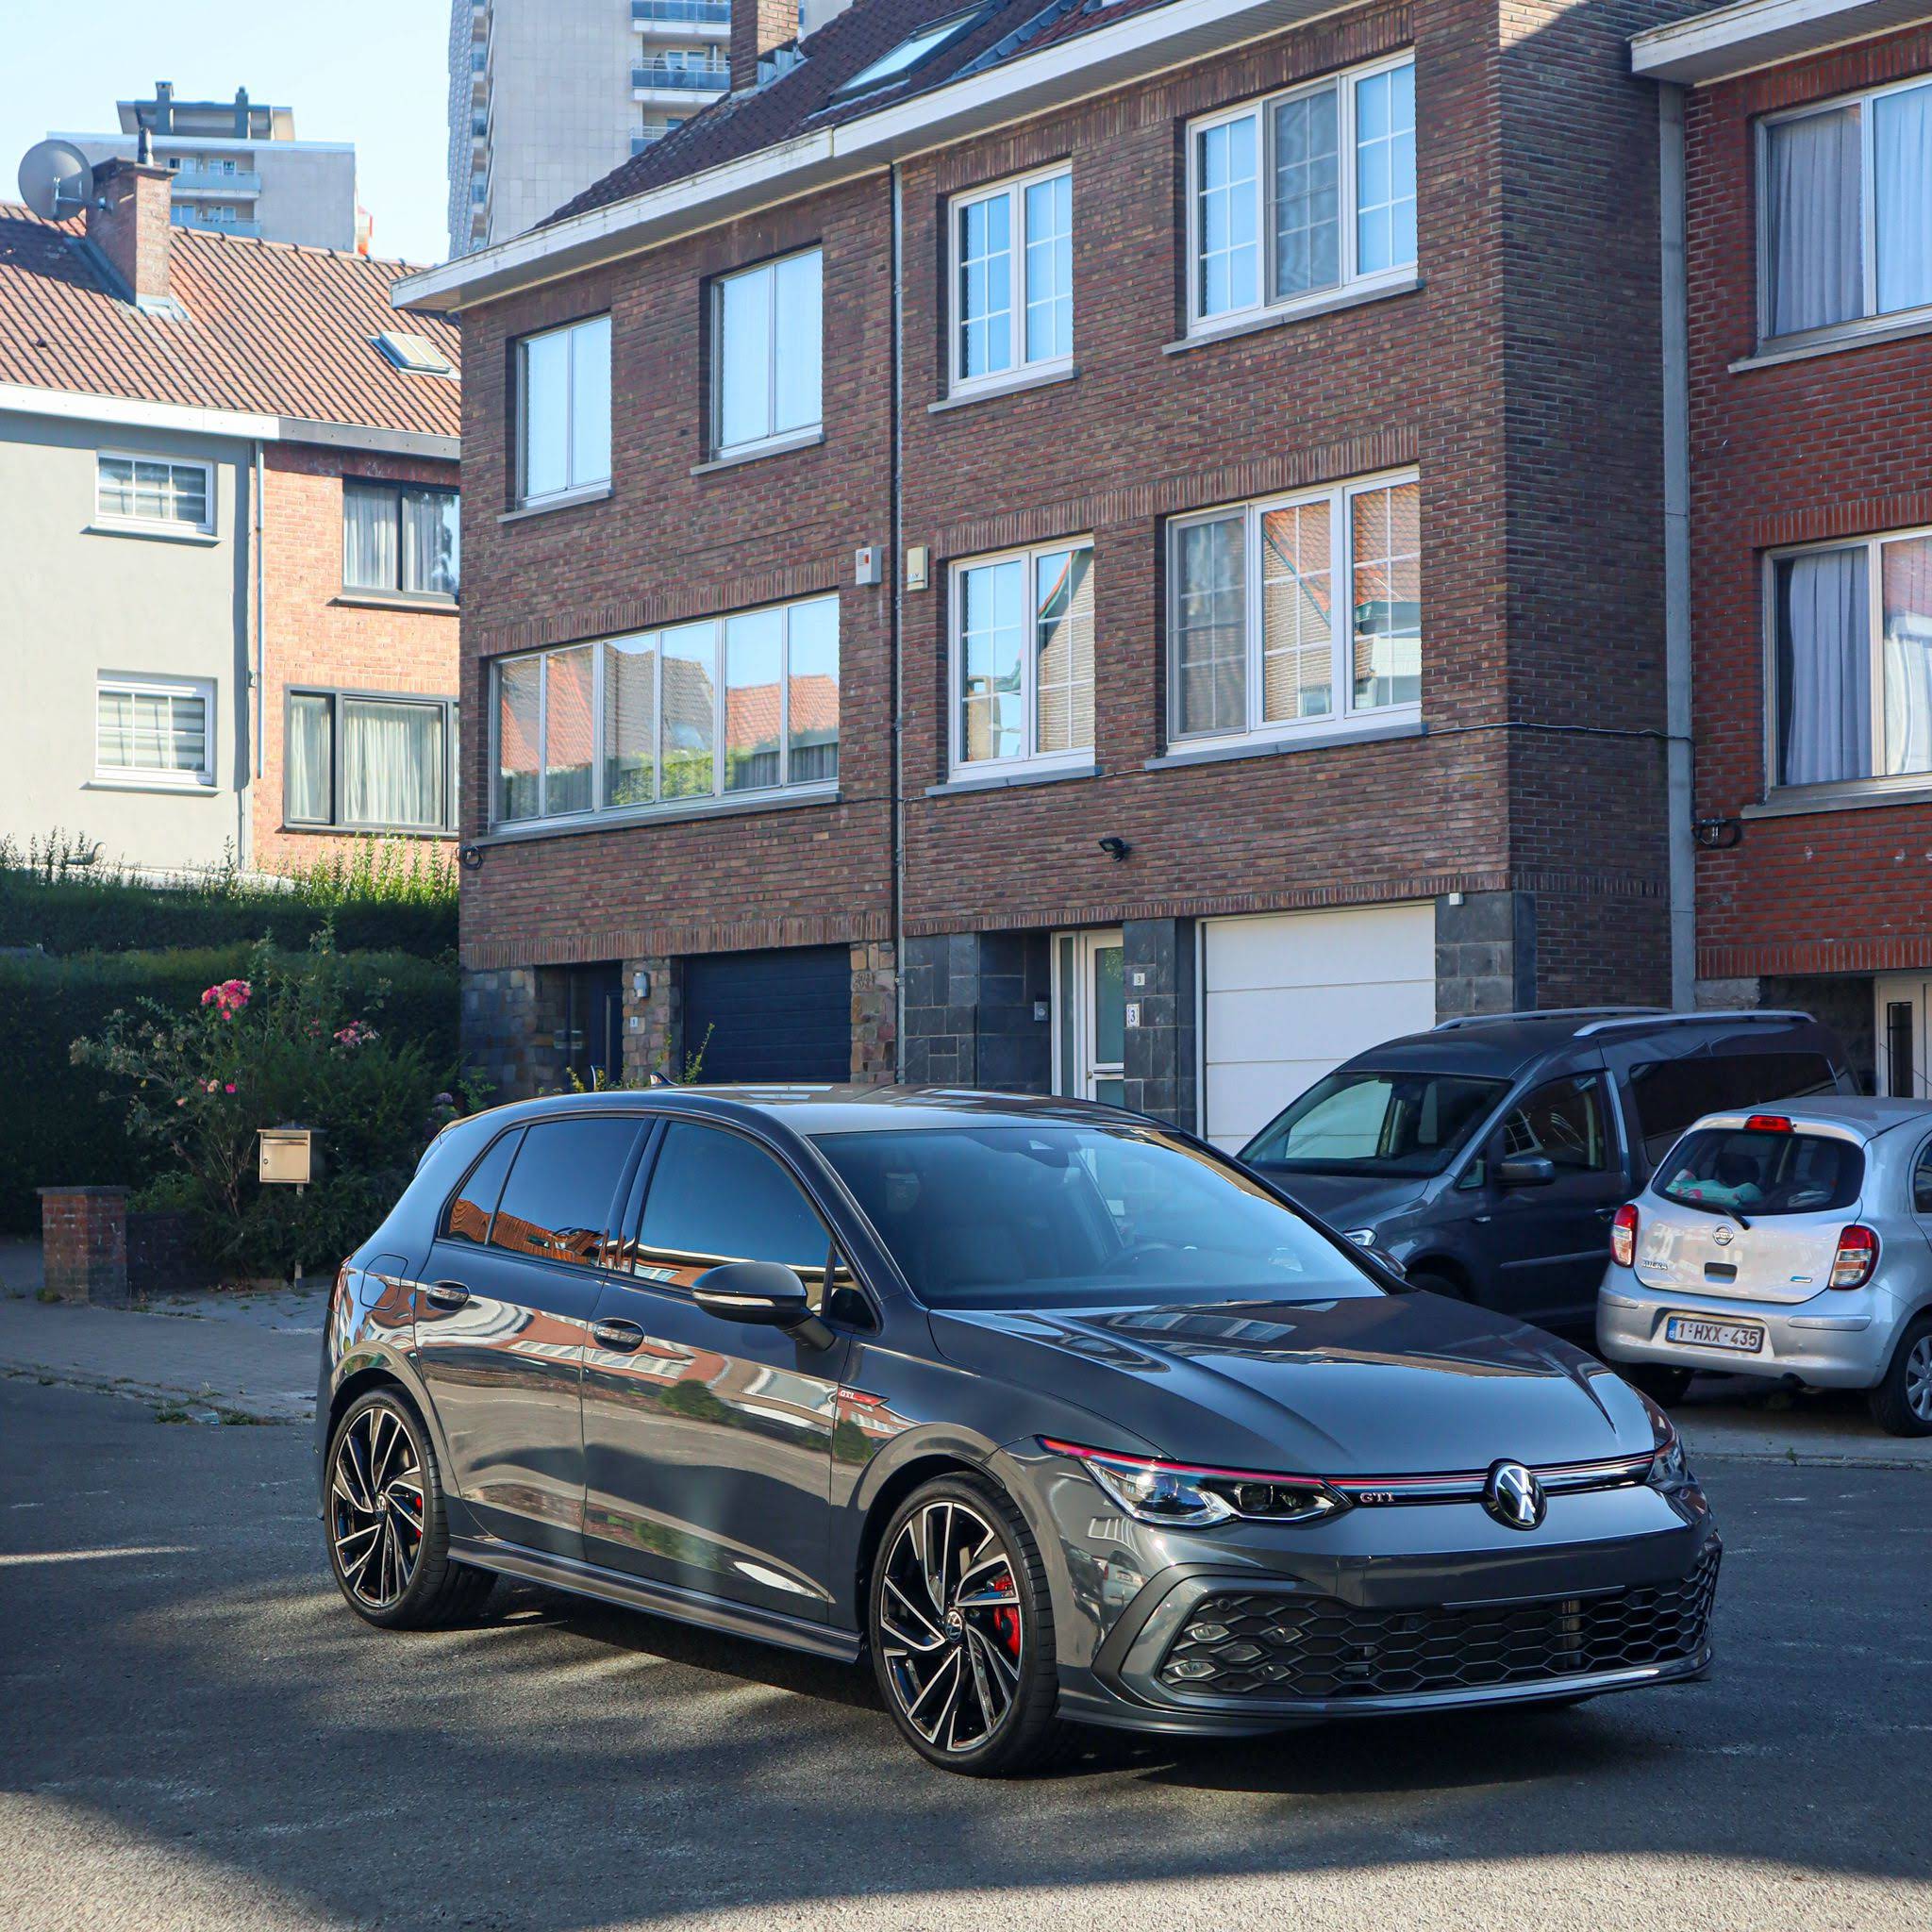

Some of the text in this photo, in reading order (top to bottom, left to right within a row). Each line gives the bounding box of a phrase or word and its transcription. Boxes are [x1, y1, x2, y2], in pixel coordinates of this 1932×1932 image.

[1130, 1009, 1136, 1023] 3
[840, 1390, 855, 1399] GTI
[1359, 1491, 1394, 1503] GTI
